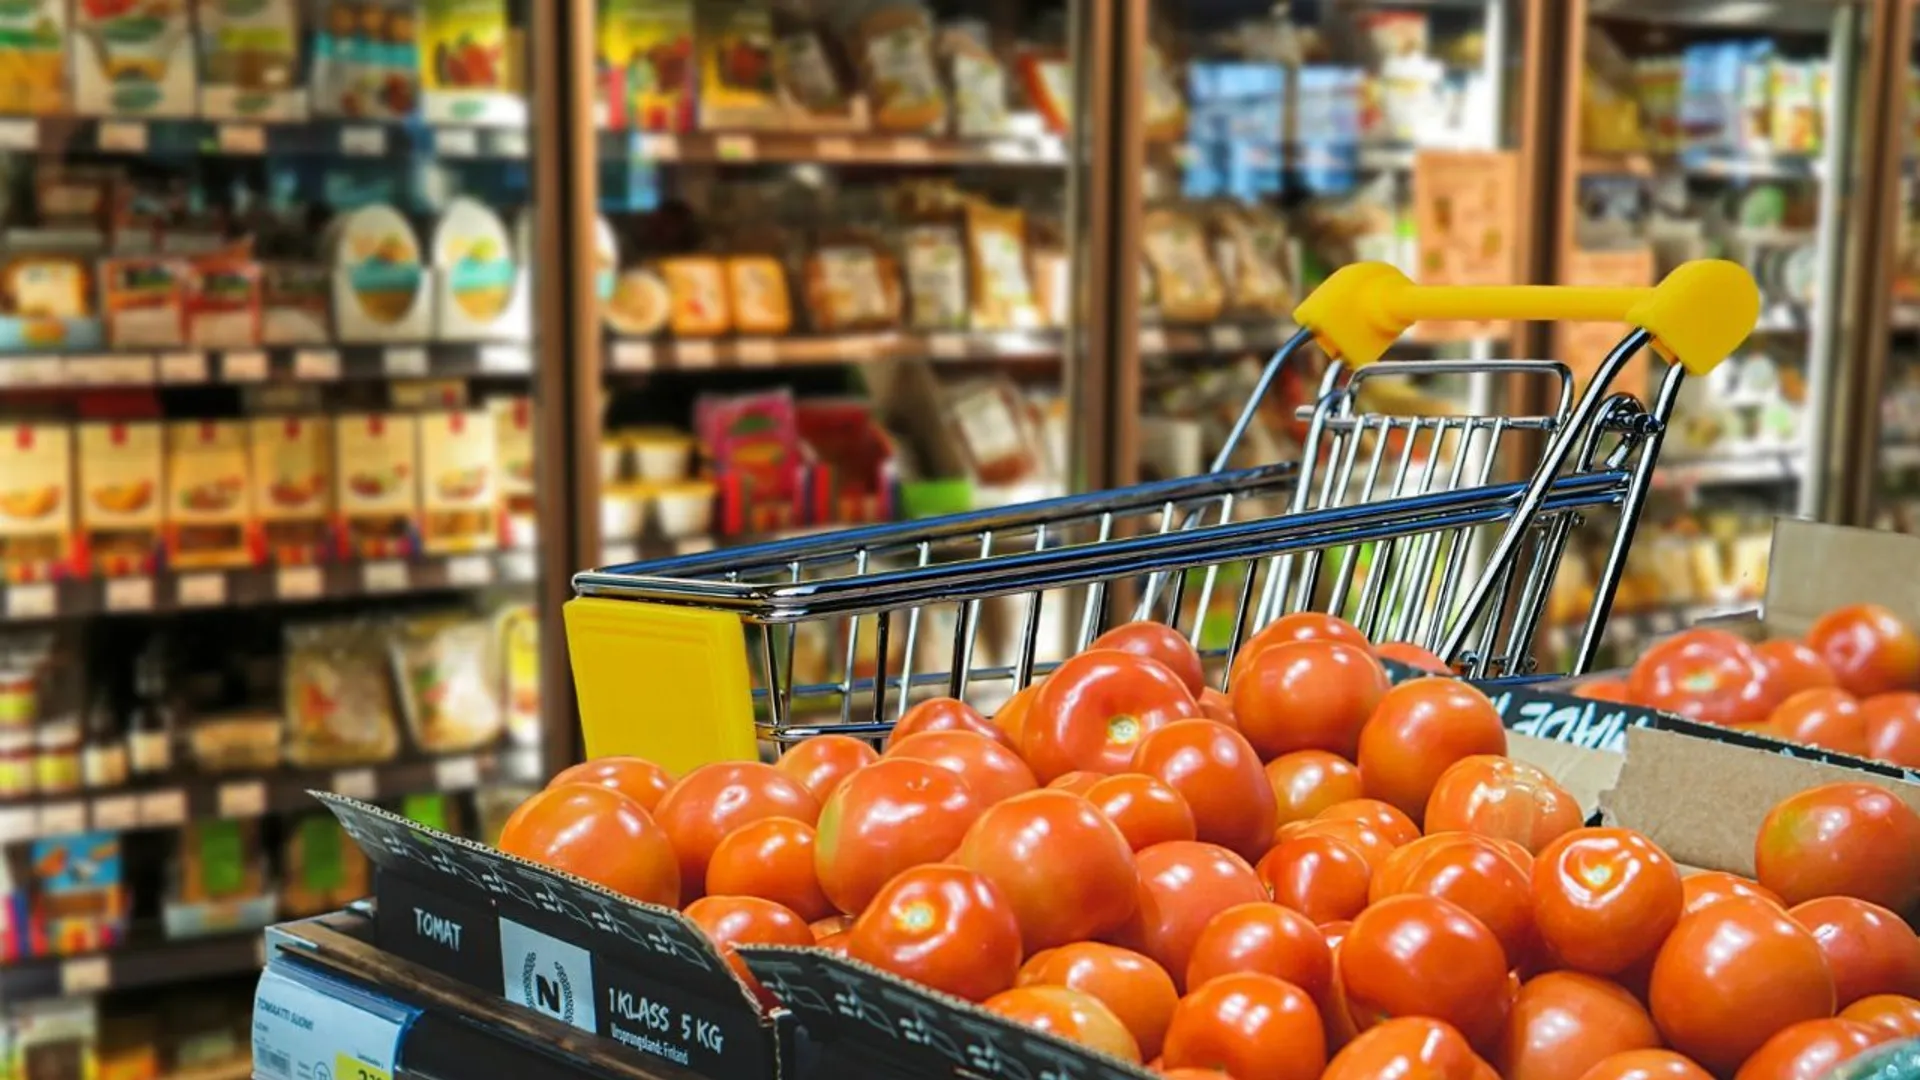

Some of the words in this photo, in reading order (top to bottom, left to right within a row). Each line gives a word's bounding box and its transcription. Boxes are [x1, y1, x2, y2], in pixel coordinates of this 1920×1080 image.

[413, 907, 463, 951] TOMAT
[535, 974, 561, 1013] N
[617, 989, 670, 1032] KLASS
[681, 1013, 692, 1040] 5
[696, 1017, 724, 1054] KG
